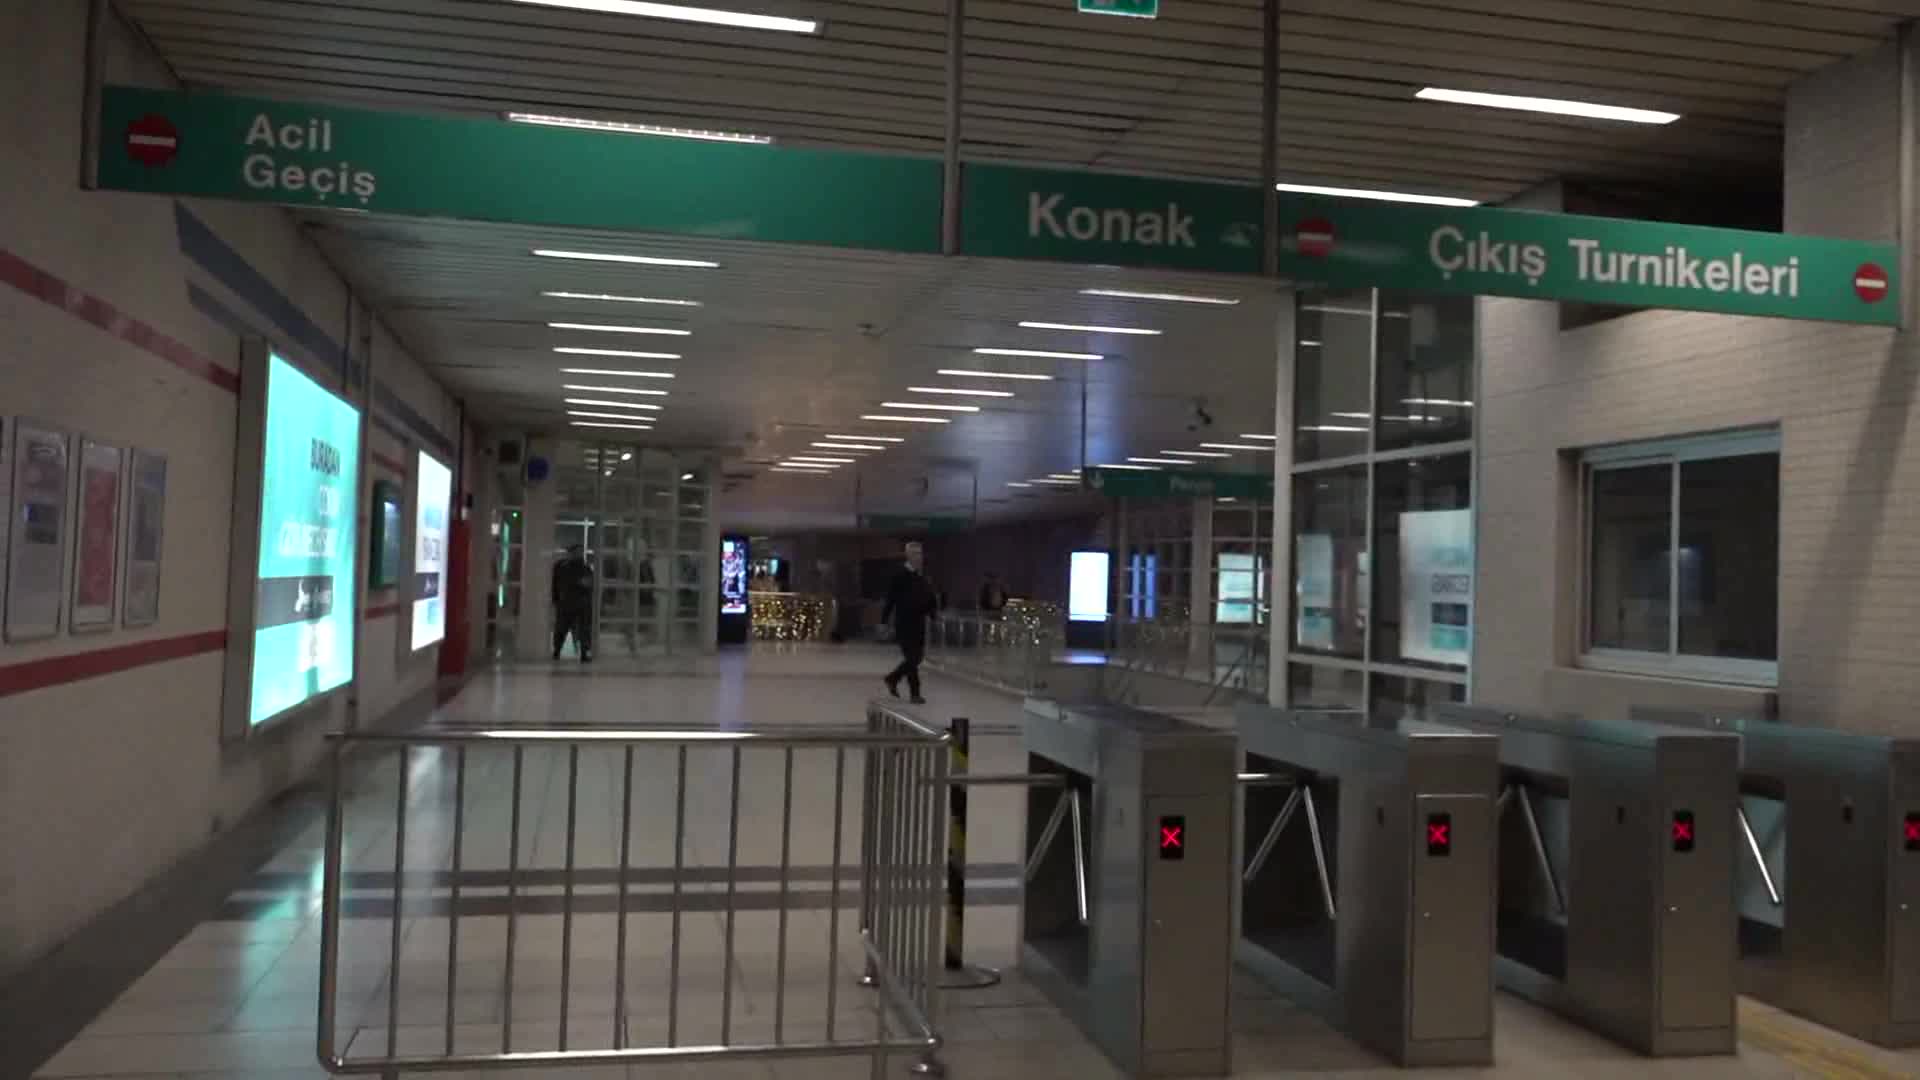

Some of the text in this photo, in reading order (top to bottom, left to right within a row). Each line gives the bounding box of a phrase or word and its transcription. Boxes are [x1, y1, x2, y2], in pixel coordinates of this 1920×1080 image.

[244, 113, 331, 152] Acil
[243, 153, 376, 204] Geçiş
[1028, 192, 1196, 248] Konak
[1429, 226, 1799, 298] Çıkış Turnikeleri
